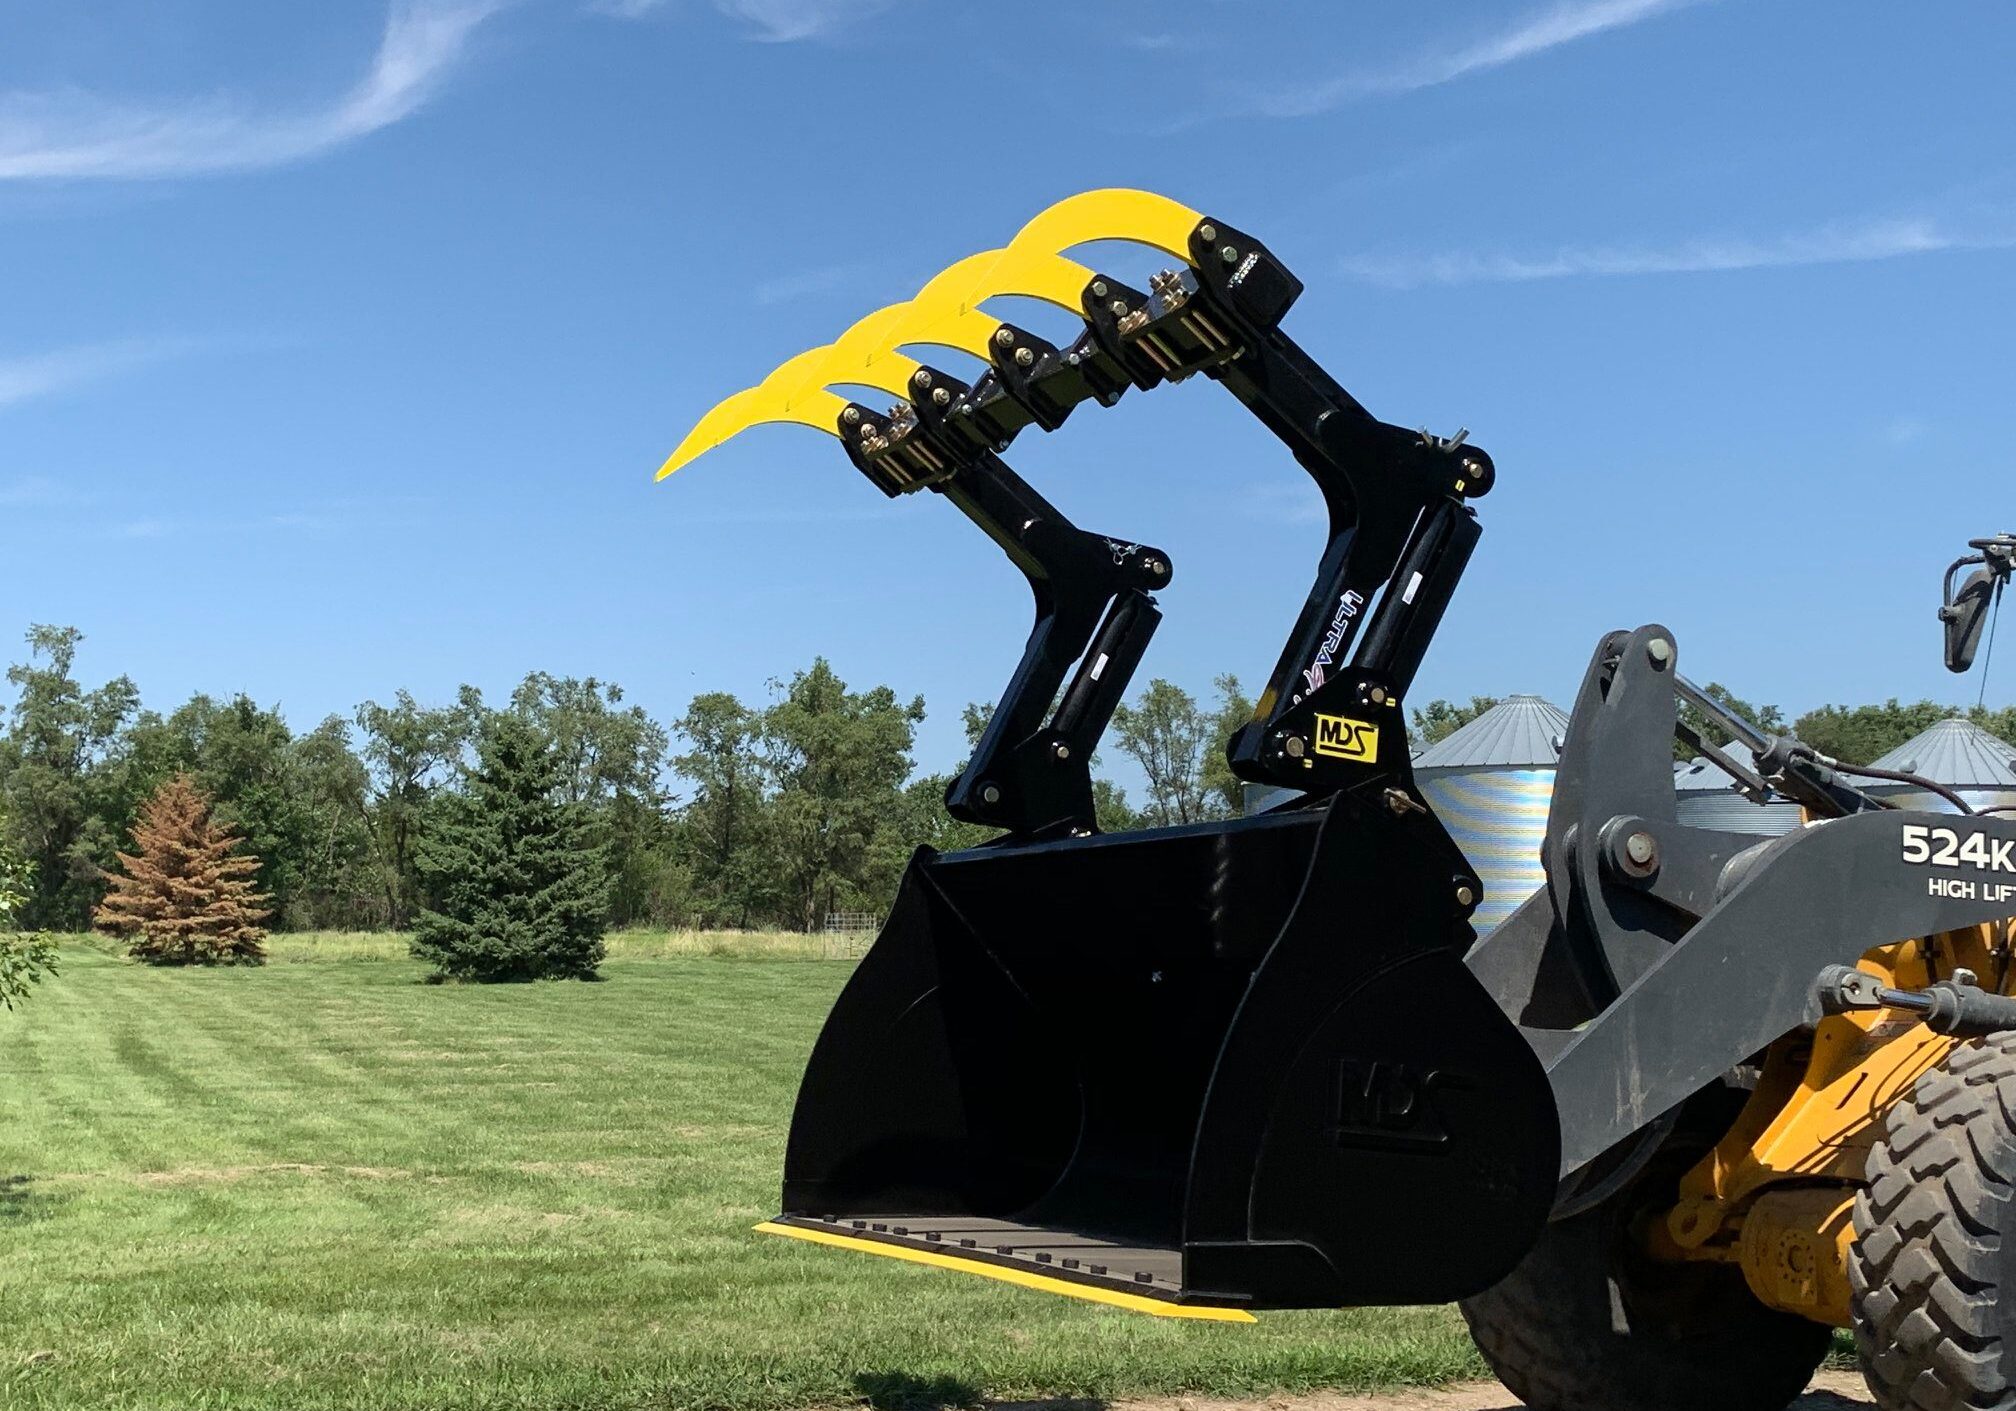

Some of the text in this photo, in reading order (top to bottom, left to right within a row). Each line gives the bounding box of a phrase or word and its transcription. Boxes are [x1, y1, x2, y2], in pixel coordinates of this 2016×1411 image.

[1320, 719, 1376, 755] MDS
[1903, 825, 2016, 872] 524K
[1928, 878, 1975, 899] HIGH
